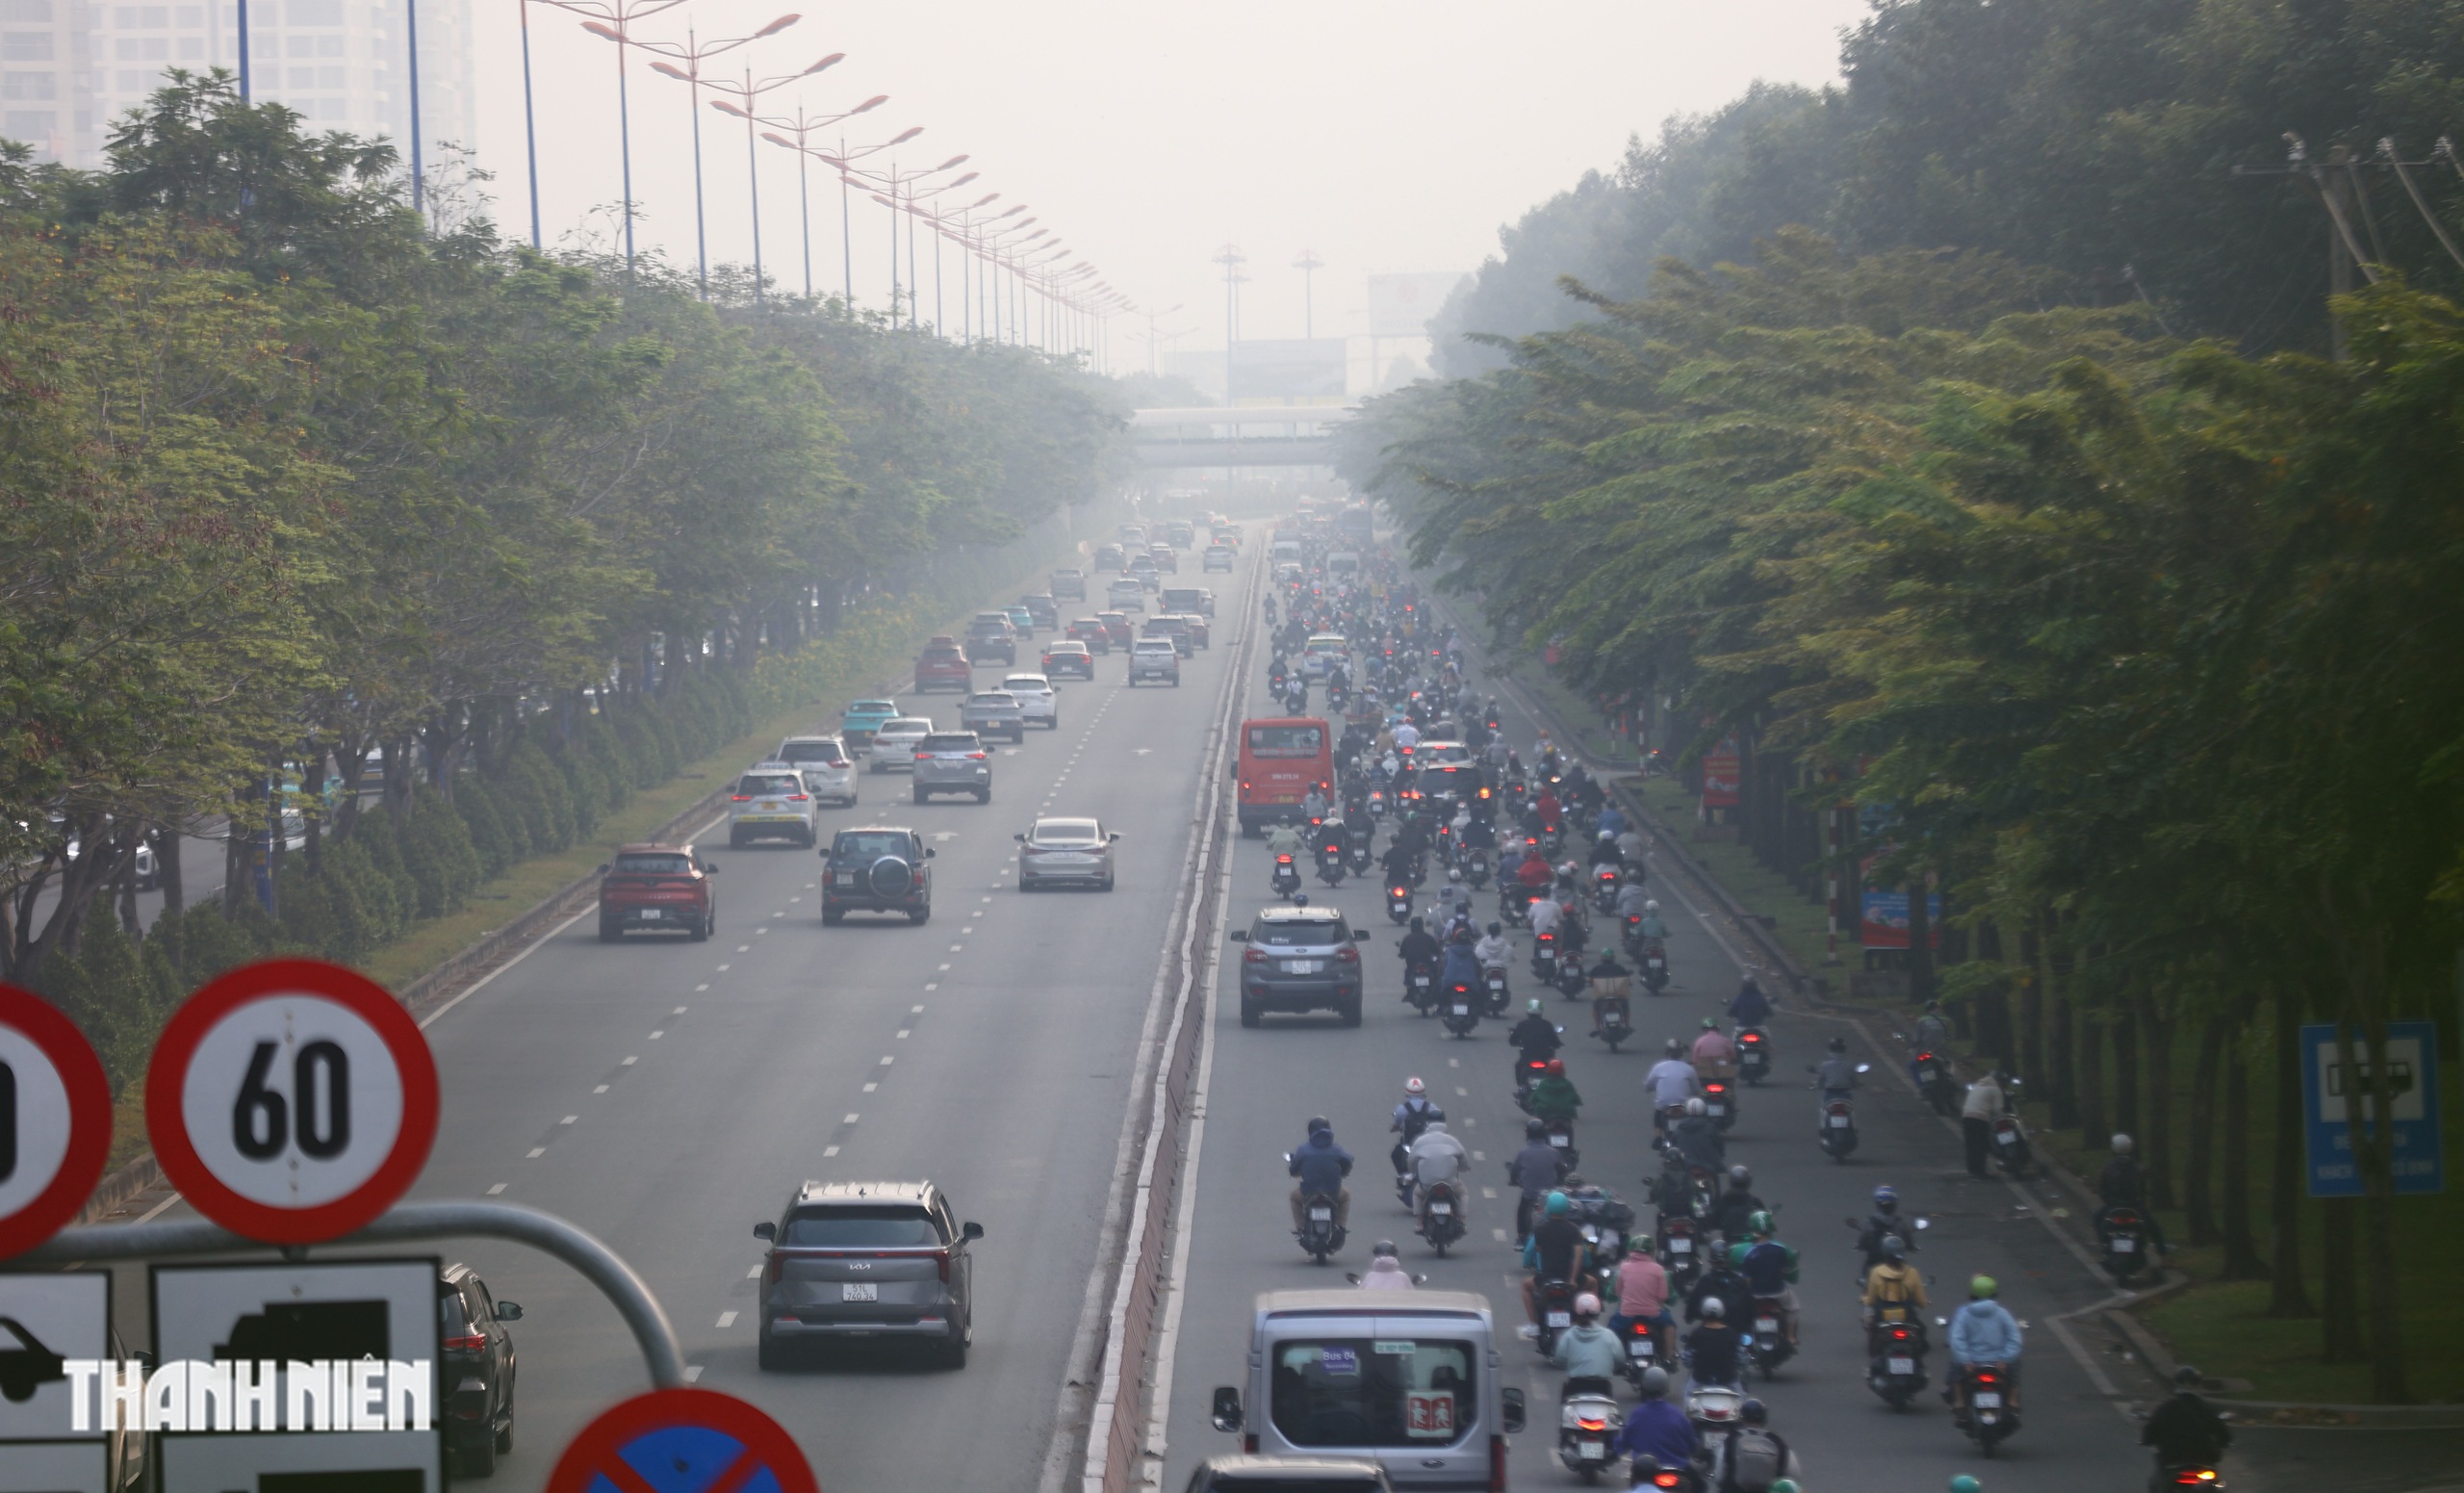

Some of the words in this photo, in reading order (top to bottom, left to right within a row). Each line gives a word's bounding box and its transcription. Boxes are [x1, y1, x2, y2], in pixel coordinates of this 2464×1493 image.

[233, 1040, 350, 1162] 60
[853, 1283, 867, 1293] 51L
[1323, 1351, 1342, 1360] Bus
[1344, 1351, 1355, 1360] 04
